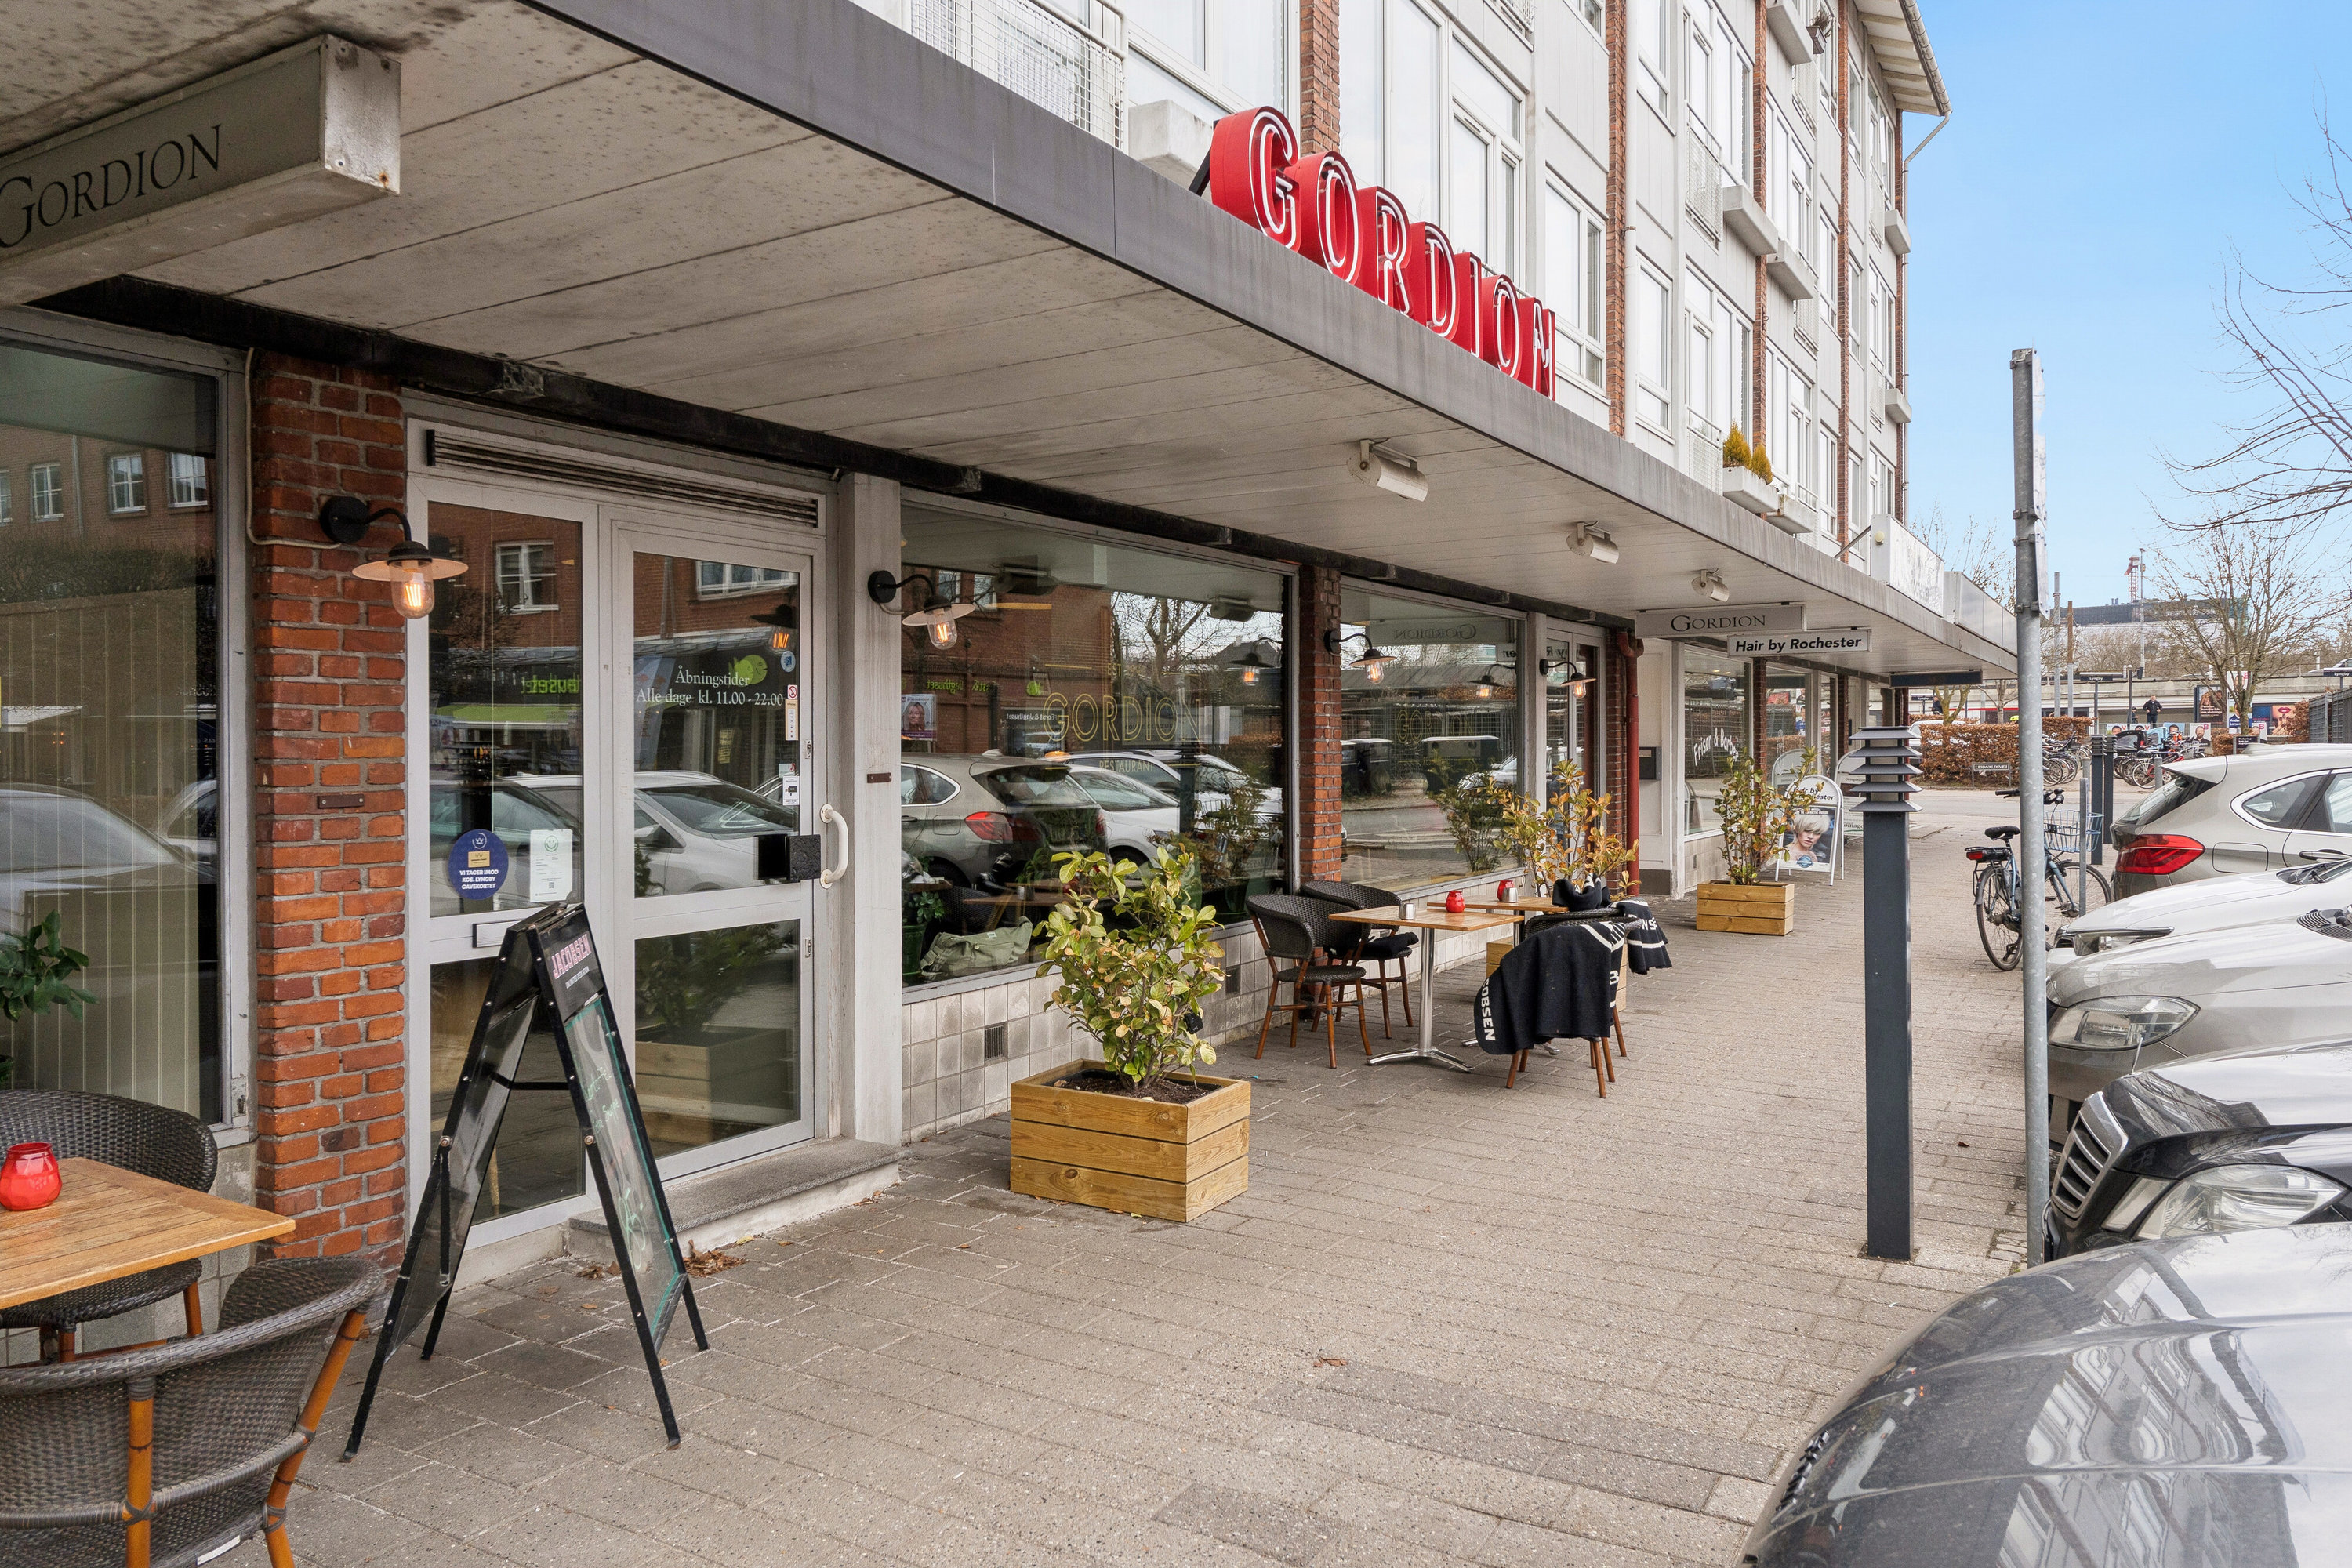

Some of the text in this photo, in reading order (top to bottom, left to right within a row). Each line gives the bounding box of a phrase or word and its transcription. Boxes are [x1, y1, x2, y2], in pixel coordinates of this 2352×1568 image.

[0, 123, 223, 249] GORDION
[1210, 105, 1557, 402] GORDION
[1671, 615, 1766, 632] GORDION
[1735, 637, 1861, 653] Hair by Rochester
[675, 665, 750, 688] Åbningstider
[636, 688, 661, 702] Alle
[665, 688, 691, 706] dage
[699, 690, 712, 704] kl.
[717, 691, 745, 705] 11.00
[754, 692, 783, 706] 22.00
[1043, 692, 1200, 742] GORDION
[1099, 760, 1153, 772] RESTAURANT
[551, 933, 592, 980] JACOBSEN
